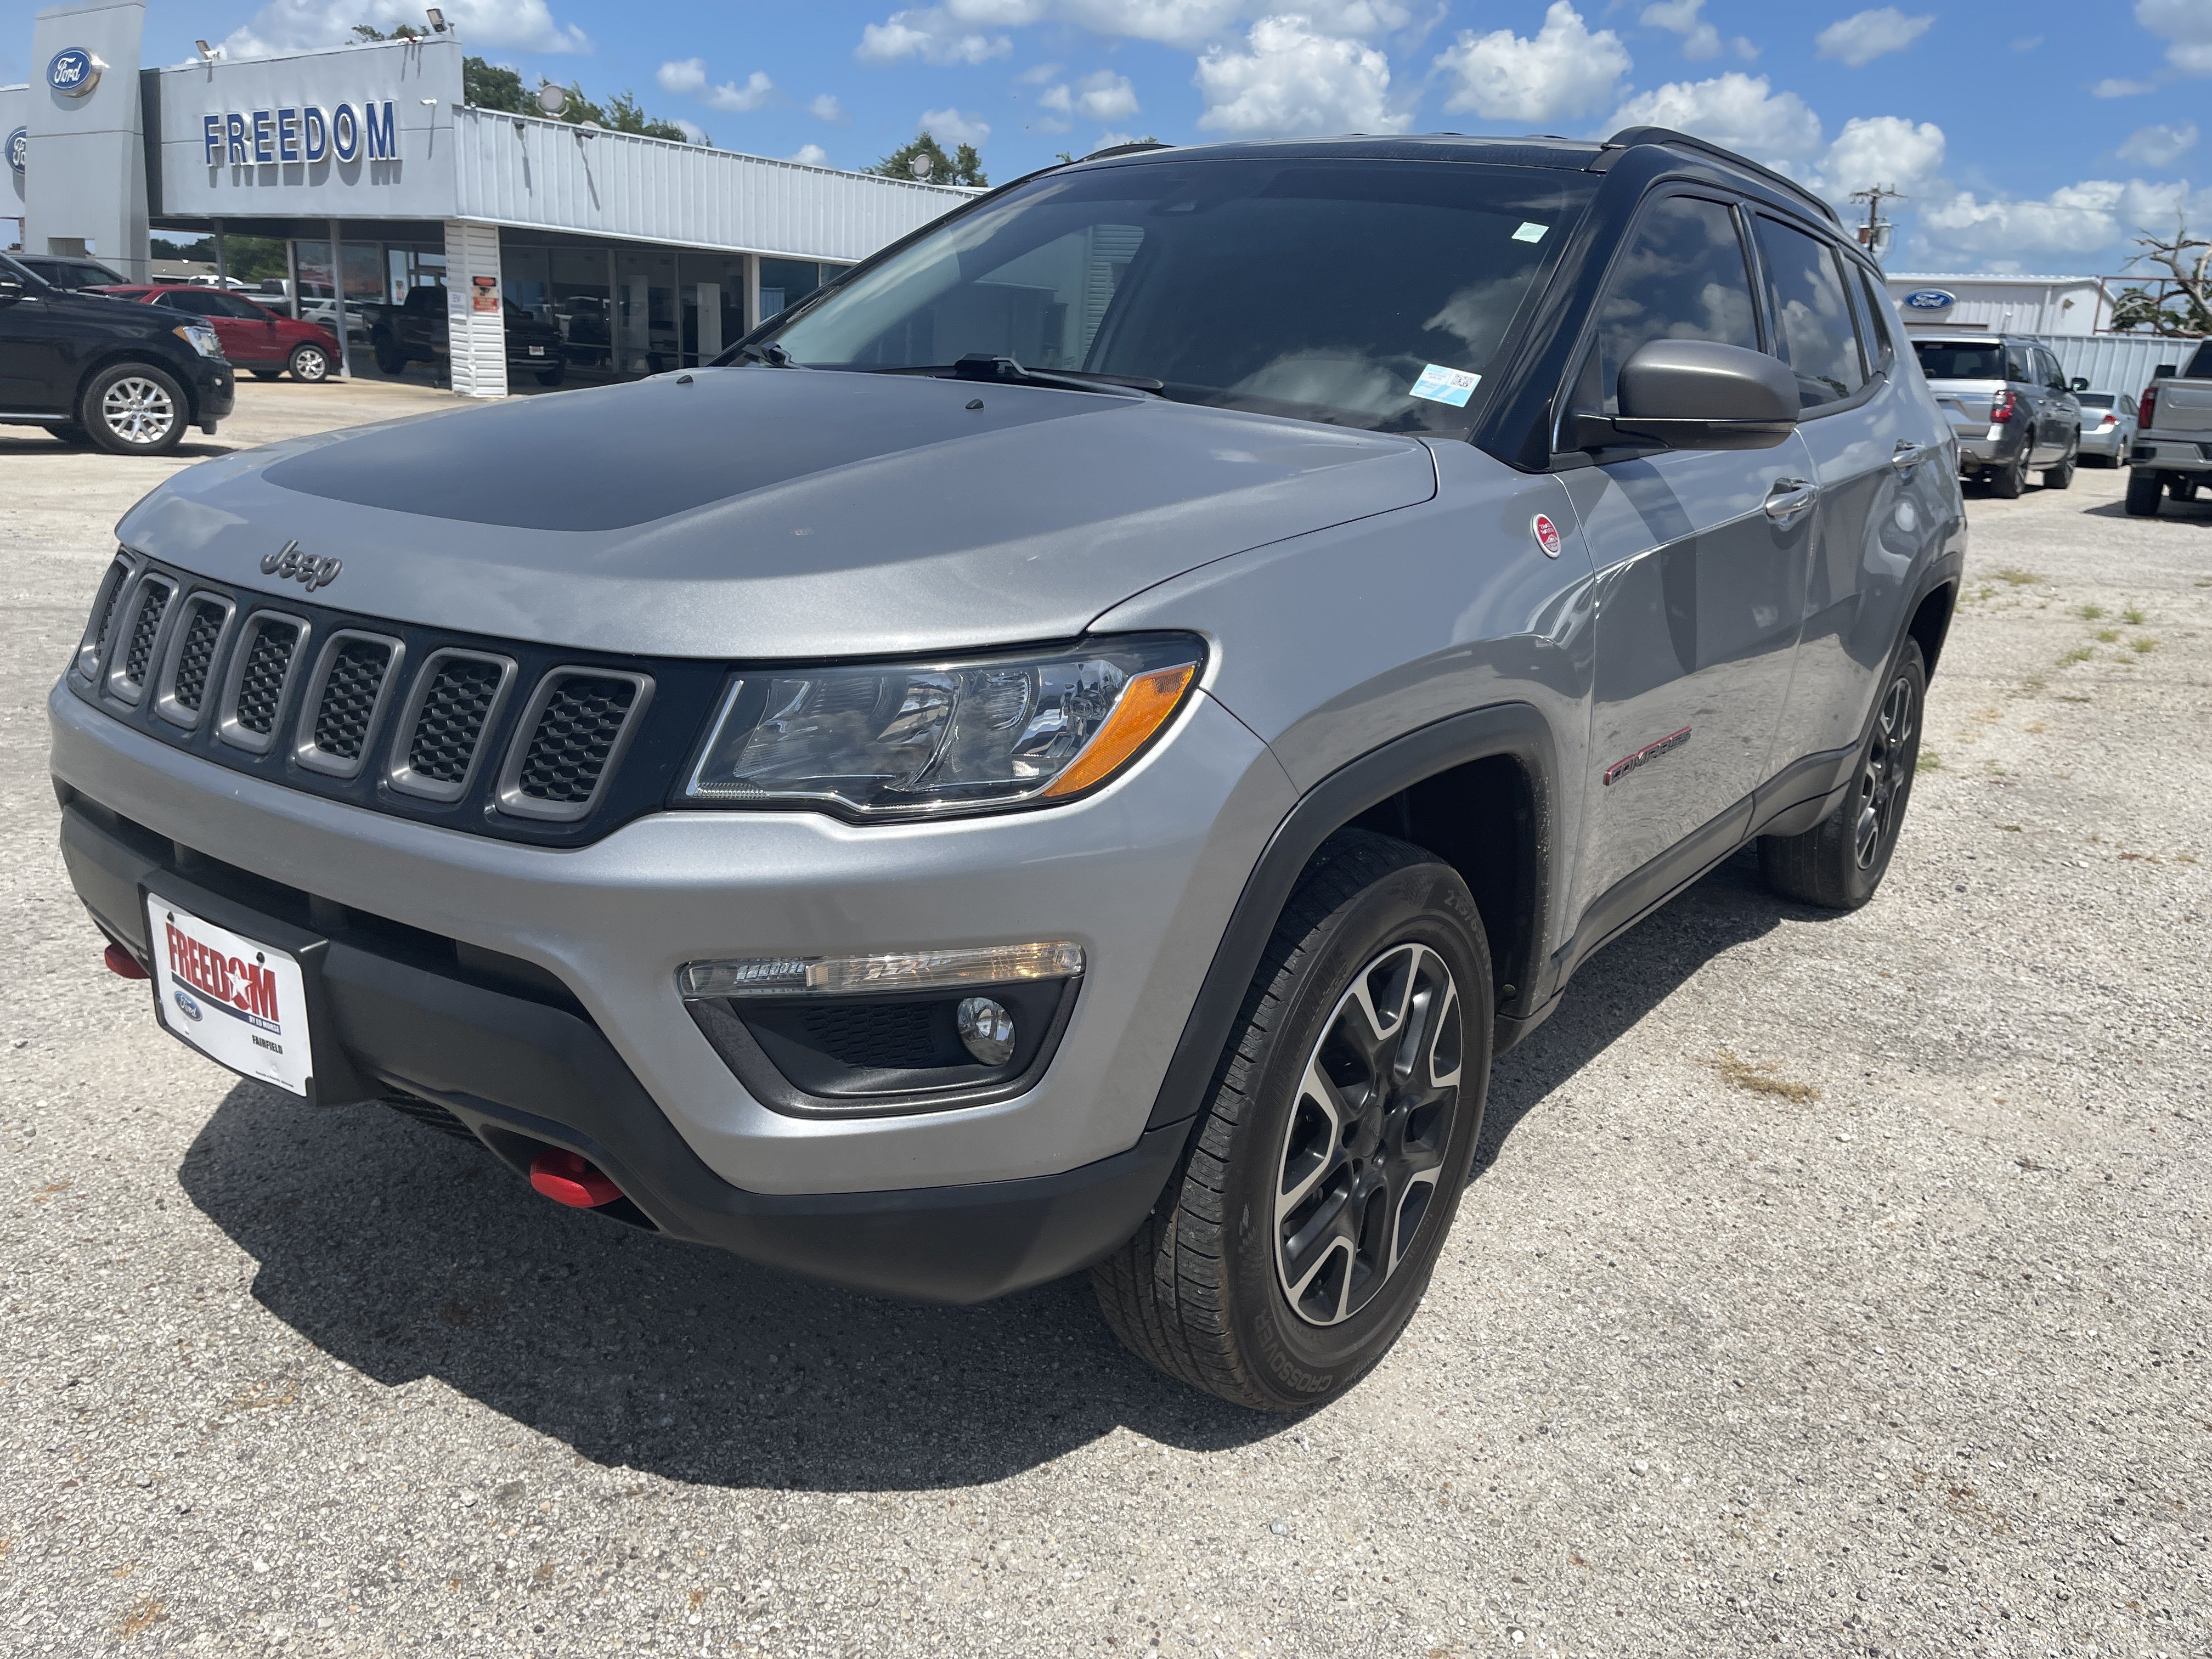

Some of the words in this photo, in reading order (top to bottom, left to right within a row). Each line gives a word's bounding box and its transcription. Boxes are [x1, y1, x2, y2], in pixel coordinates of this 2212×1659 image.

[54, 57, 83, 84] Ford
[202, 99, 398, 167] FREEDOM
[12, 137, 27, 166] Fo
[1912, 292, 1945, 306] Ford
[260, 540, 343, 592] Jeep
[165, 921, 280, 1022] FREEDOM
[179, 995, 197, 1018] Ford
[252, 1035, 283, 1054] FAIRFIELD
[1255, 1308, 1334, 1392] CROSSOVER
